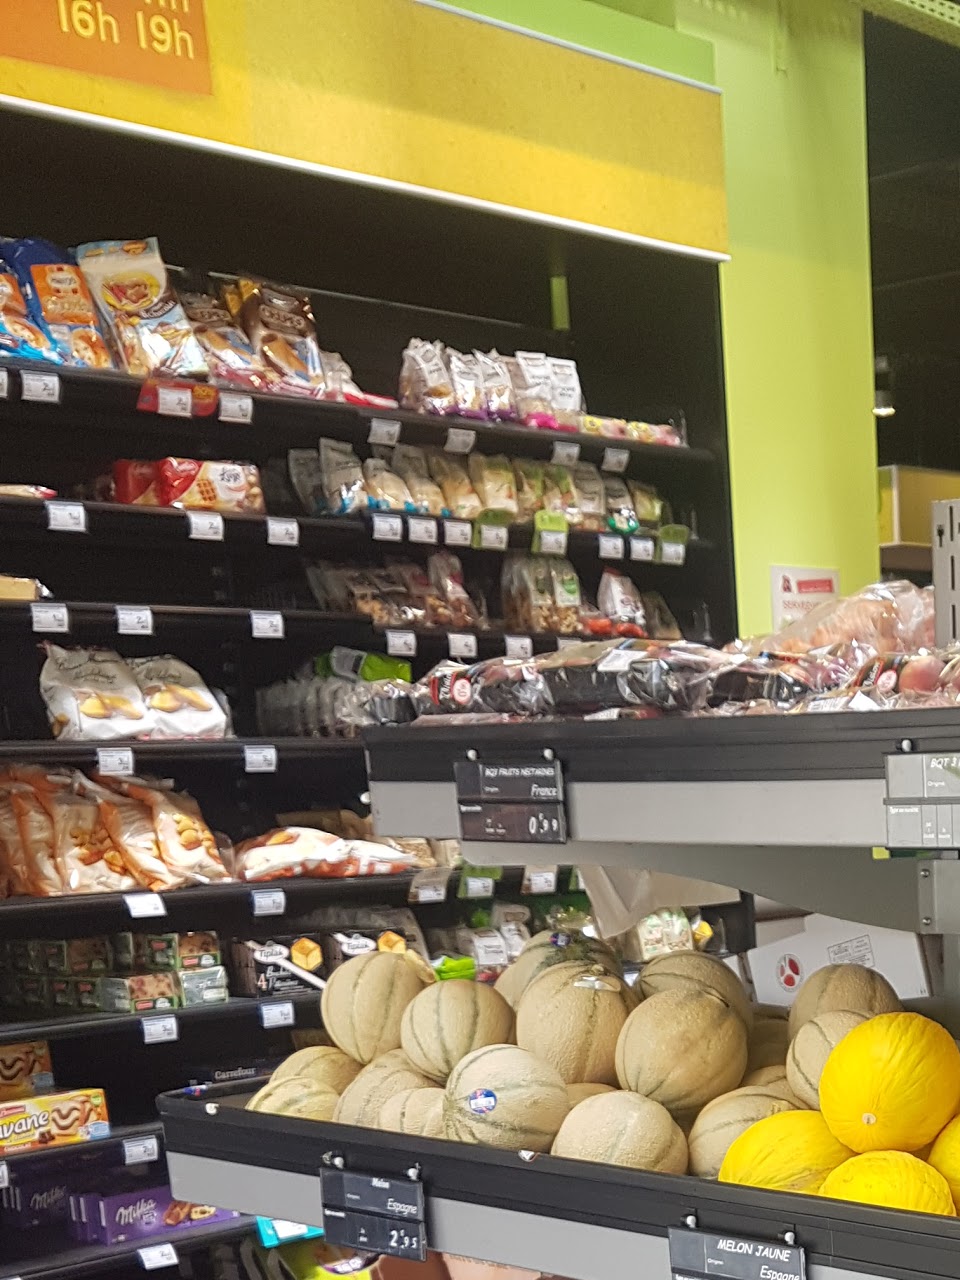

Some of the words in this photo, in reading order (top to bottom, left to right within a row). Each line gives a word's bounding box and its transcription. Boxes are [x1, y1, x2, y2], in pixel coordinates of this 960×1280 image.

[58, 0, 120, 44] 16h
[135, 11, 195, 60] 19h
[930, 757, 950, 768] BQT
[951, 757, 958, 767] 3
[499, 768, 520, 777] FRUITS
[531, 784, 557, 796] France
[215, 1066, 257, 1079] Carrefour
[0, 1111, 50, 1139] vane
[116, 1198, 156, 1226] Milka
[387, 1198, 418, 1214] Espagne
[717, 1239, 753, 1254] MELON
[755, 1246, 791, 1262] JAUNE
